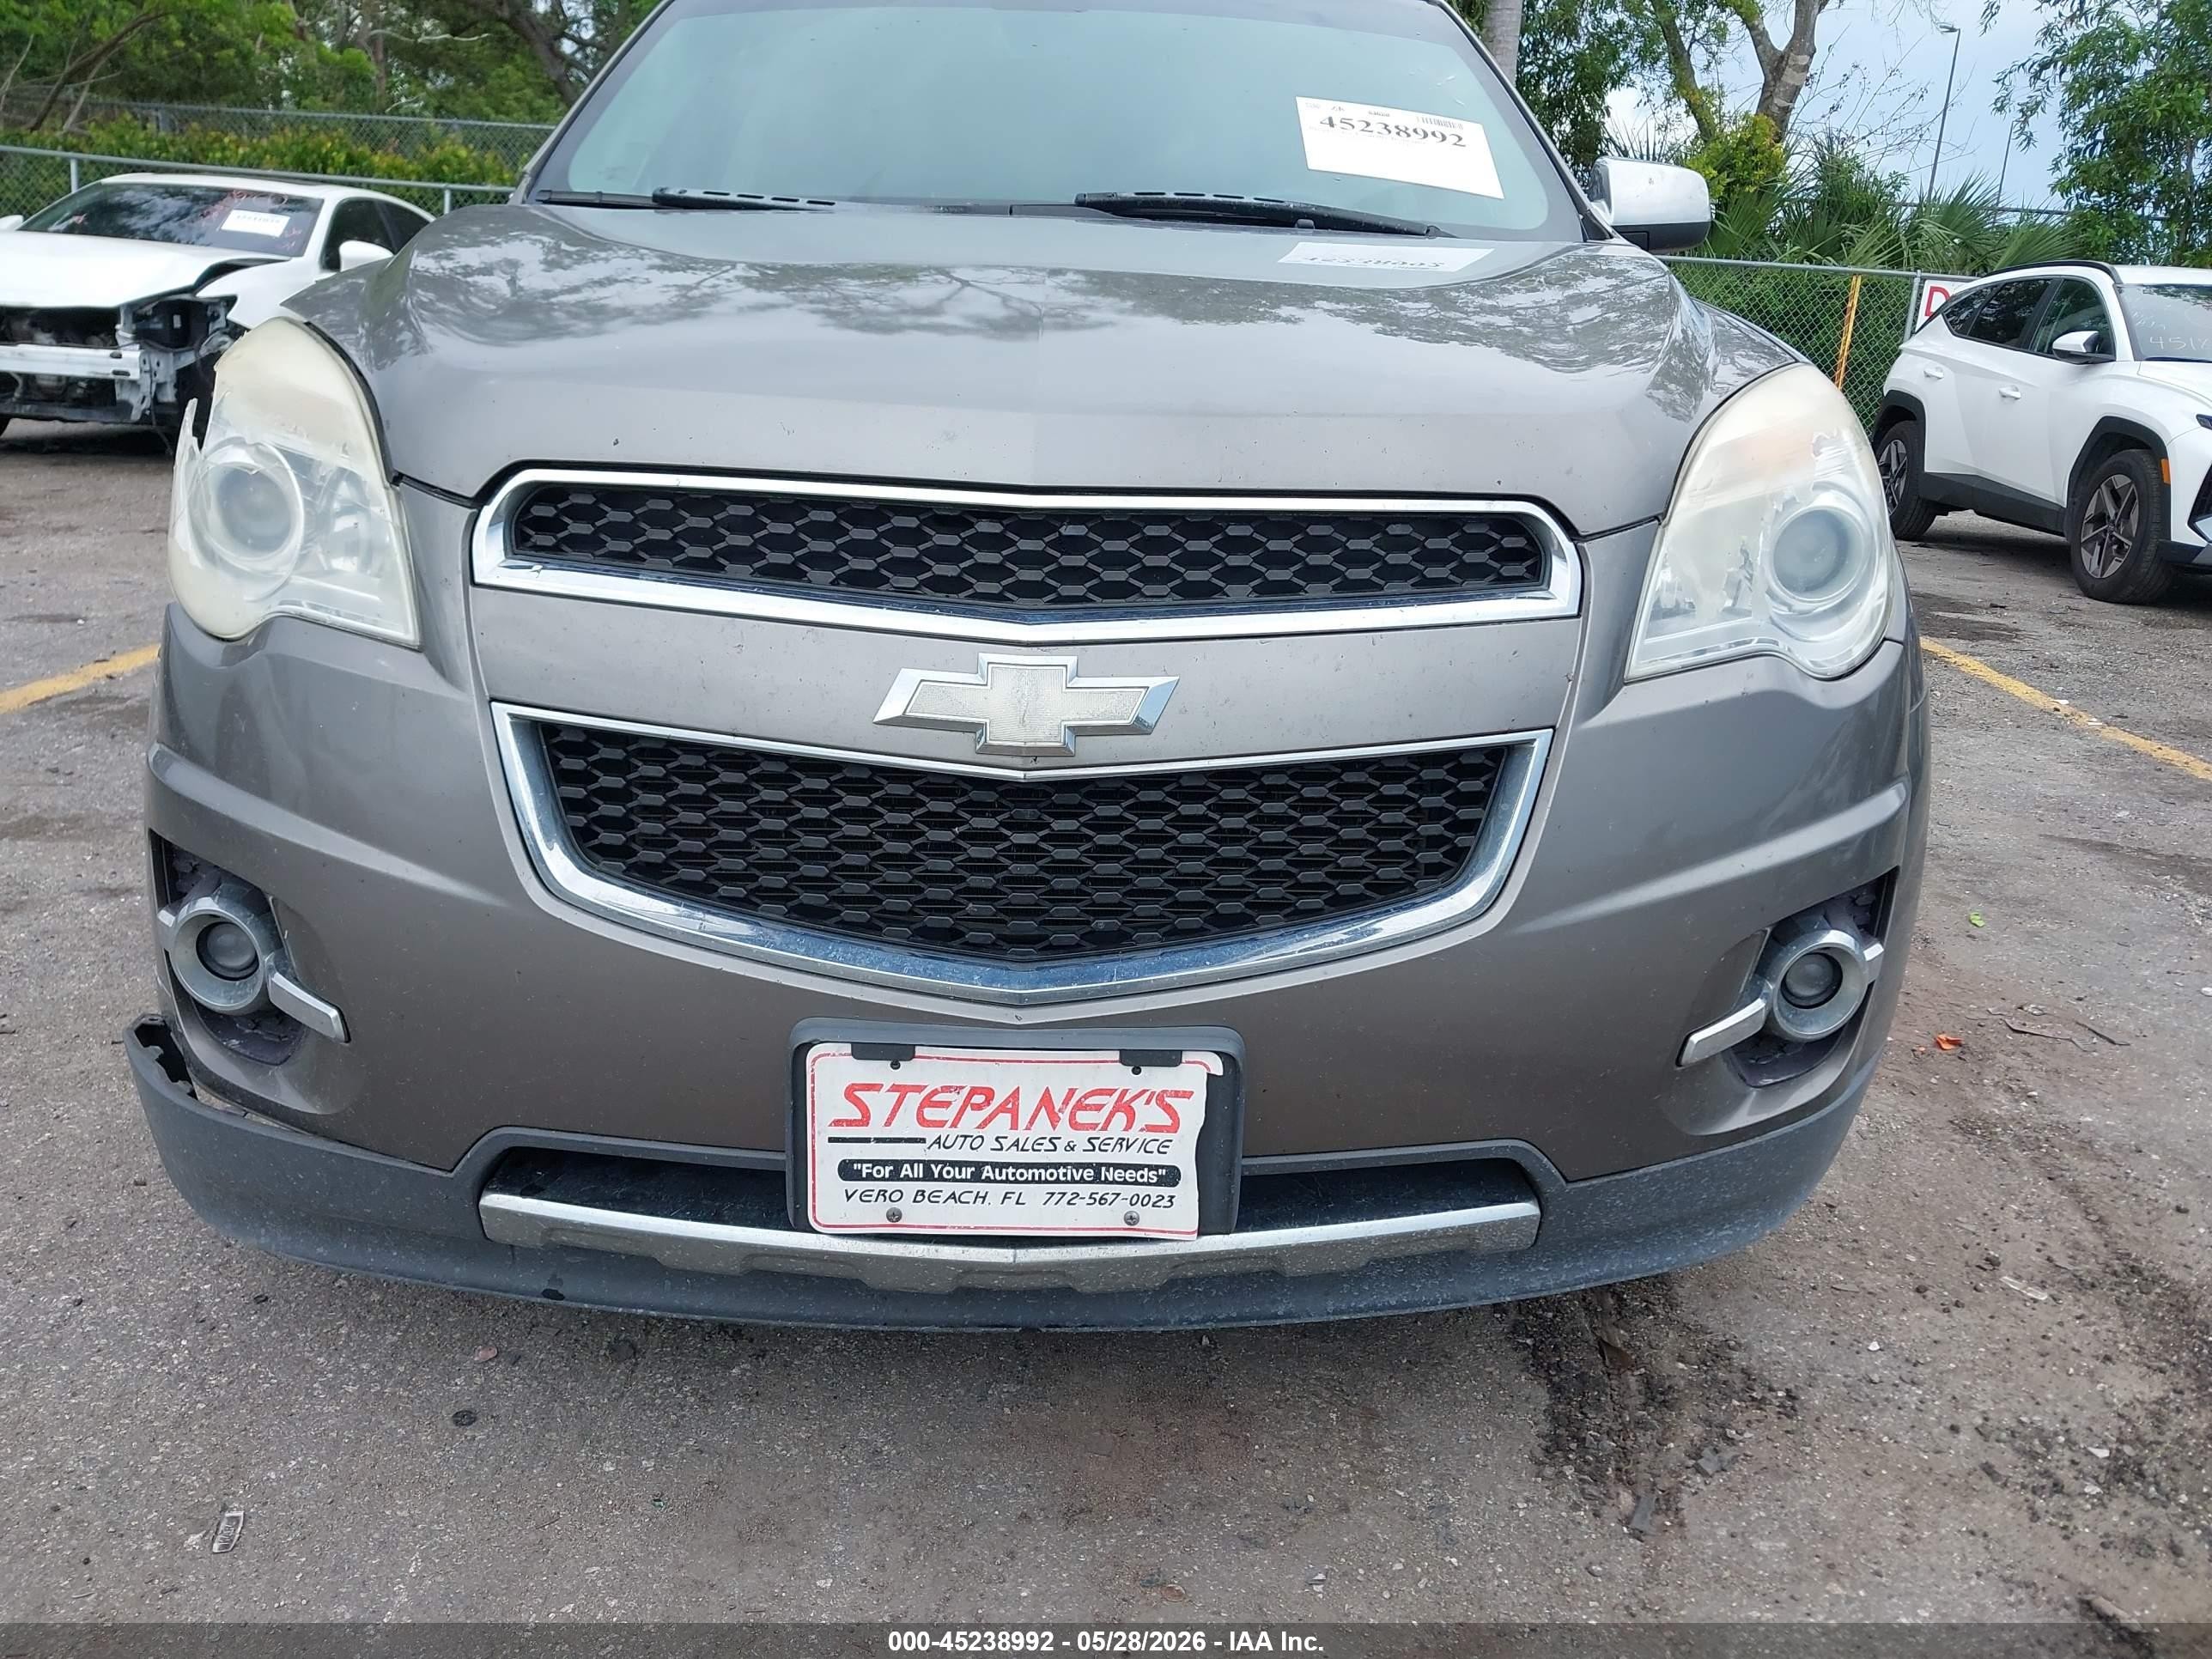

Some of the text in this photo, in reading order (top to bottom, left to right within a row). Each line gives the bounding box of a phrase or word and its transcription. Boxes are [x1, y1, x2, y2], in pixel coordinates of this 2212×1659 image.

[1320, 115, 1467, 147] 45238992
[828, 1083, 1194, 1133] STEPANEK'S
[927, 1134, 1173, 1155] AUTO SALES & SERVICE
[853, 1163, 1167, 1183] "For All Your Automotive Needs"
[844, 1188, 904, 1203] VERO
[1000, 1191, 1027, 1206] FL
[1042, 1191, 1176, 1209] 772-567-0023
